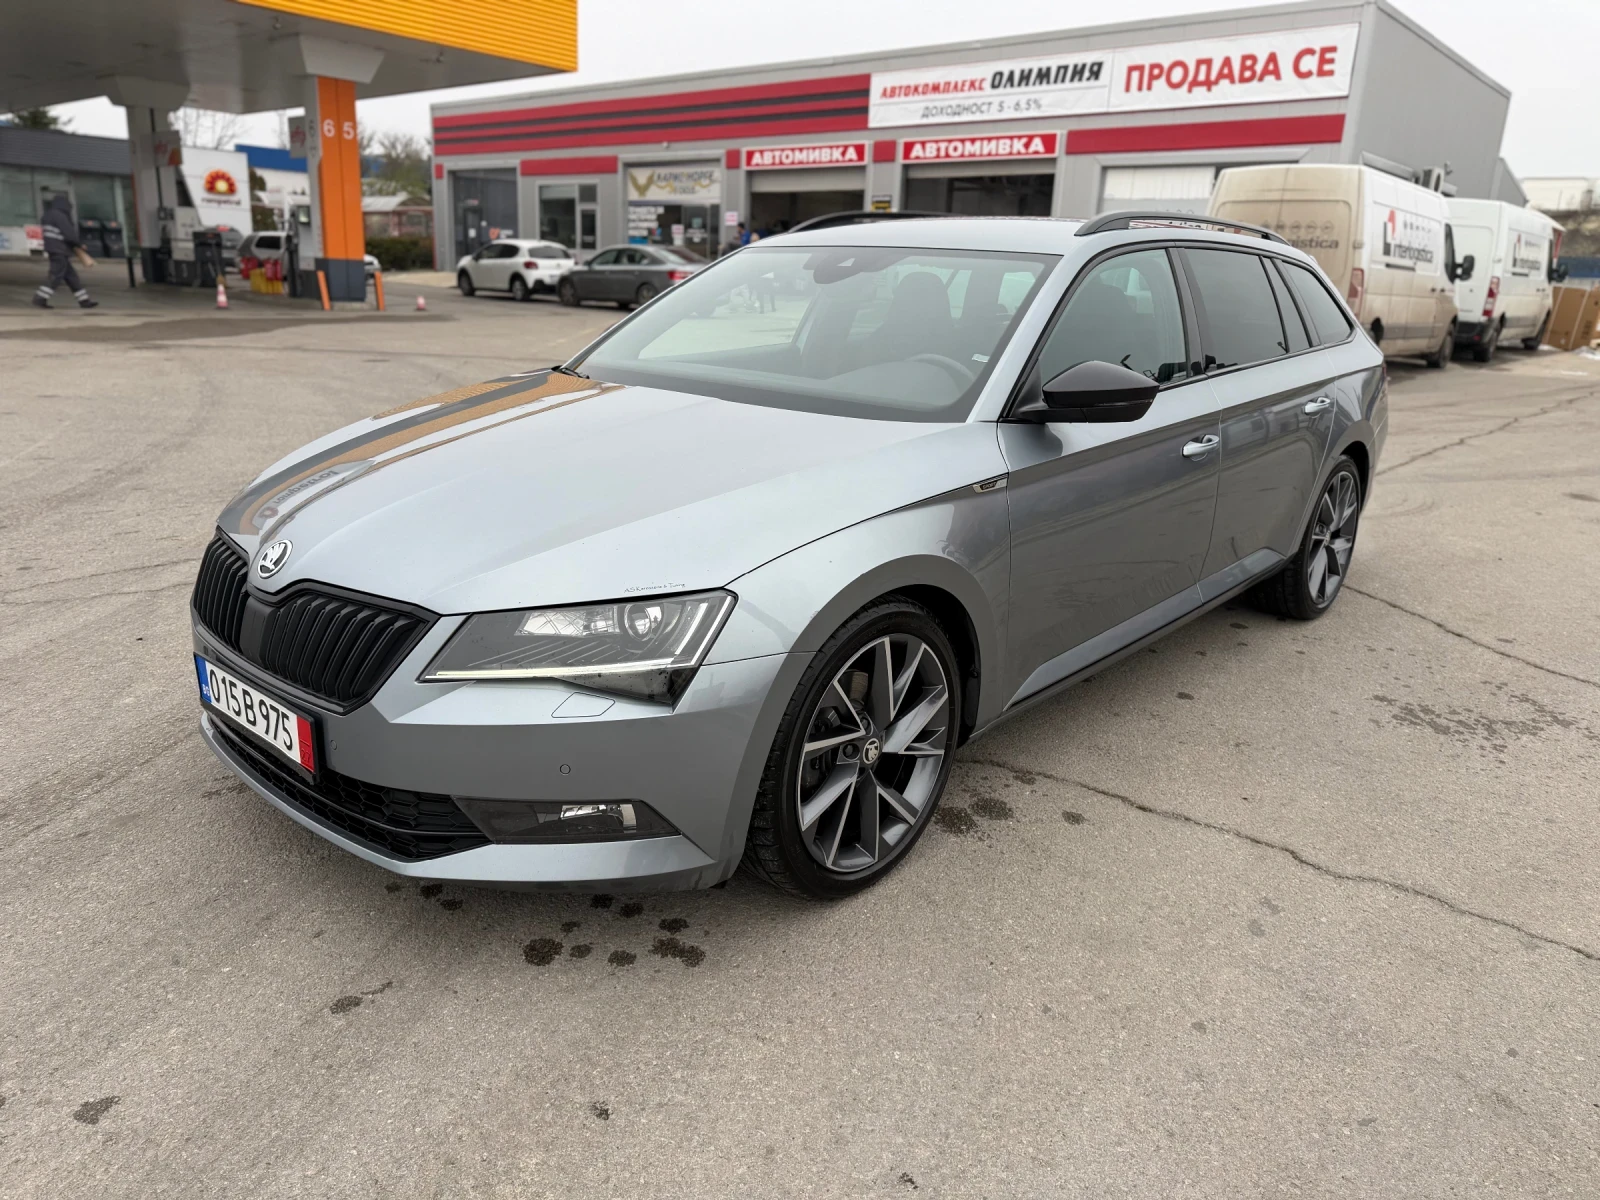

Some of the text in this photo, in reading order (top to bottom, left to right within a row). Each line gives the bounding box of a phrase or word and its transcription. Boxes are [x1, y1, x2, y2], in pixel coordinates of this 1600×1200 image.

[1124, 45, 1338, 93] ПРОДАВА СЕ
[880, 61, 1104, 99] АВТОКОМПЛЕКС ОЛИМПИЯ
[921, 101, 993, 119] ДОХОДНОСТ
[323, 118, 335, 138] 6
[342, 121, 355, 140] 5
[750, 146, 859, 166] АВТОМИВКА
[910, 136, 1046, 159] АВТОМИВКА
[209, 669, 293, 751] 015B975
